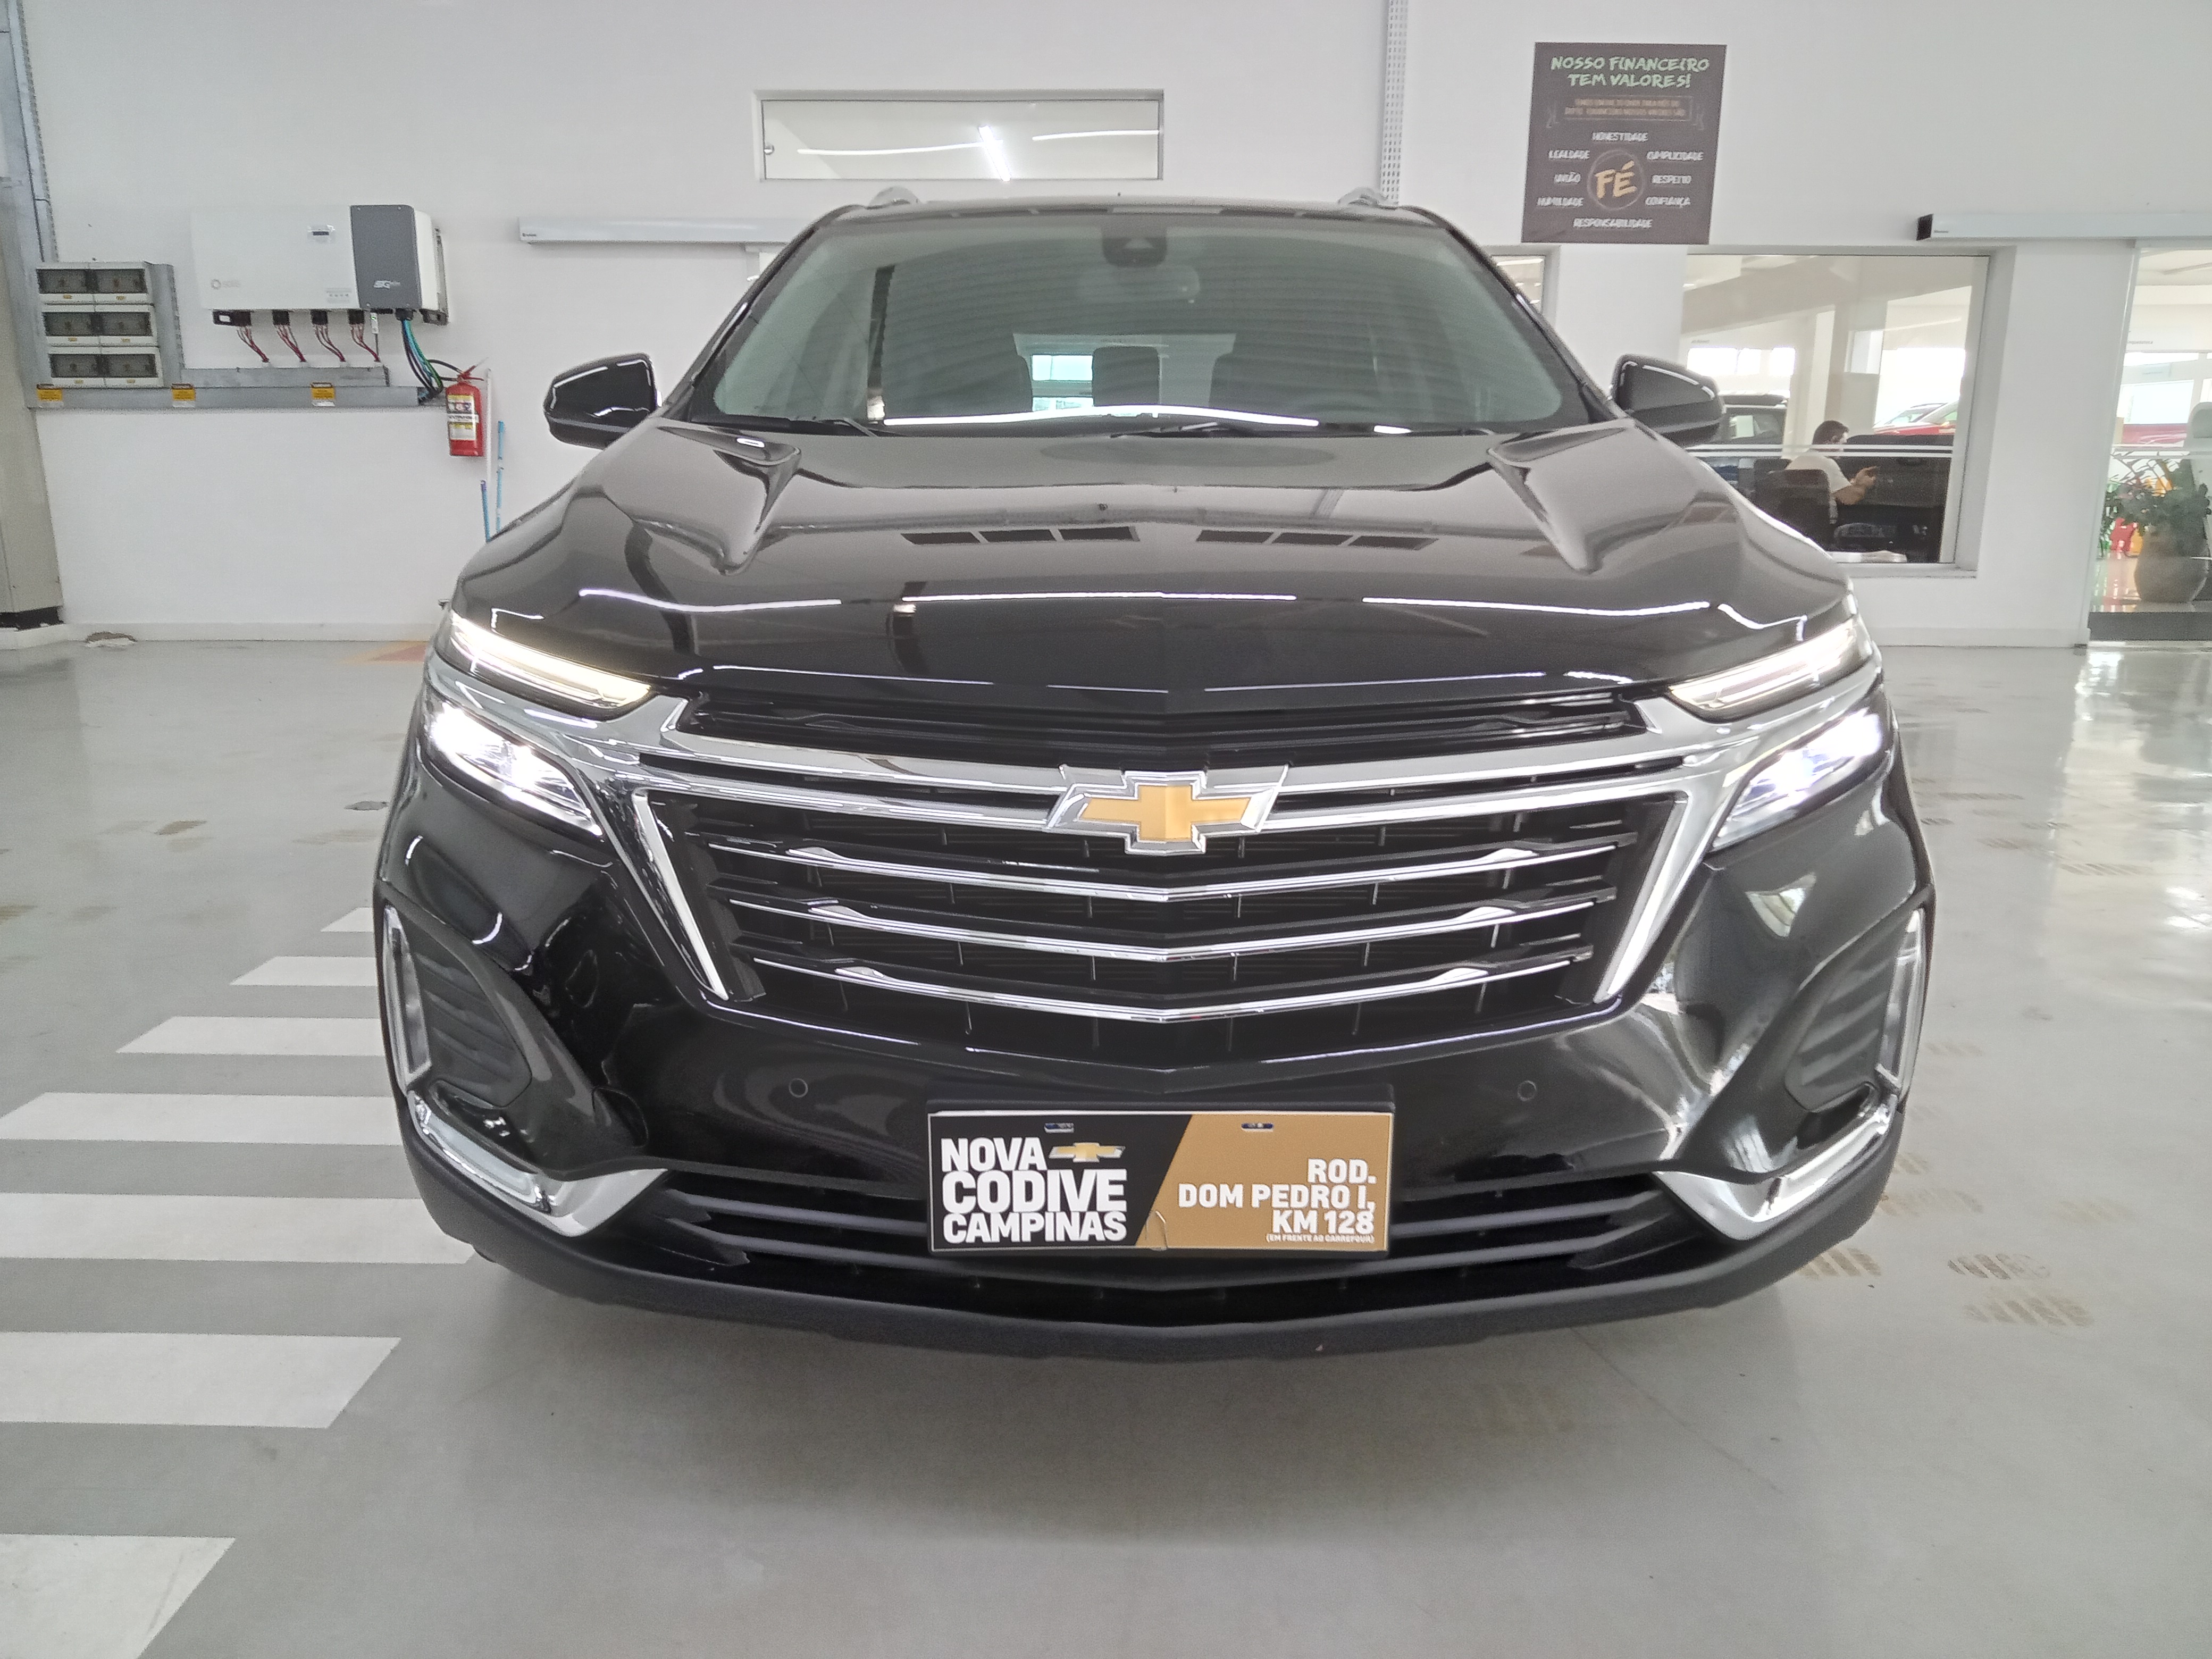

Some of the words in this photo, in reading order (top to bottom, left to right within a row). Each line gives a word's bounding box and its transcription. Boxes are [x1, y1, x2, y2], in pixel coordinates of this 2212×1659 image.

[1551, 56, 1606, 70] NOSSO
[1609, 56, 1710, 72] FINANCEIRO
[1568, 73, 1606, 86] TEM
[1610, 73, 1691, 88] VALORES!
[1548, 149, 1591, 160] LEALDADE
[1595, 160, 1638, 198] FÉ
[1651, 174, 1692, 185] RESPEITO
[1645, 197, 1691, 208] CONFIANÇA
[1573, 217, 1653, 229] RESPONSABILIDADE
[941, 1137, 1048, 1172] NOVA
[1308, 1158, 1377, 1184] ROD.
[942, 1169, 1128, 1214] CODIVE
[1178, 1183, 1244, 1208] DOM
[1251, 1184, 1351, 1209] PEDRO
[1358, 1185, 1376, 1213] I,
[943, 1211, 1127, 1243] CAMPINAS
[1272, 1210, 1318, 1234] KM
[1323, 1211, 1375, 1235] 128
